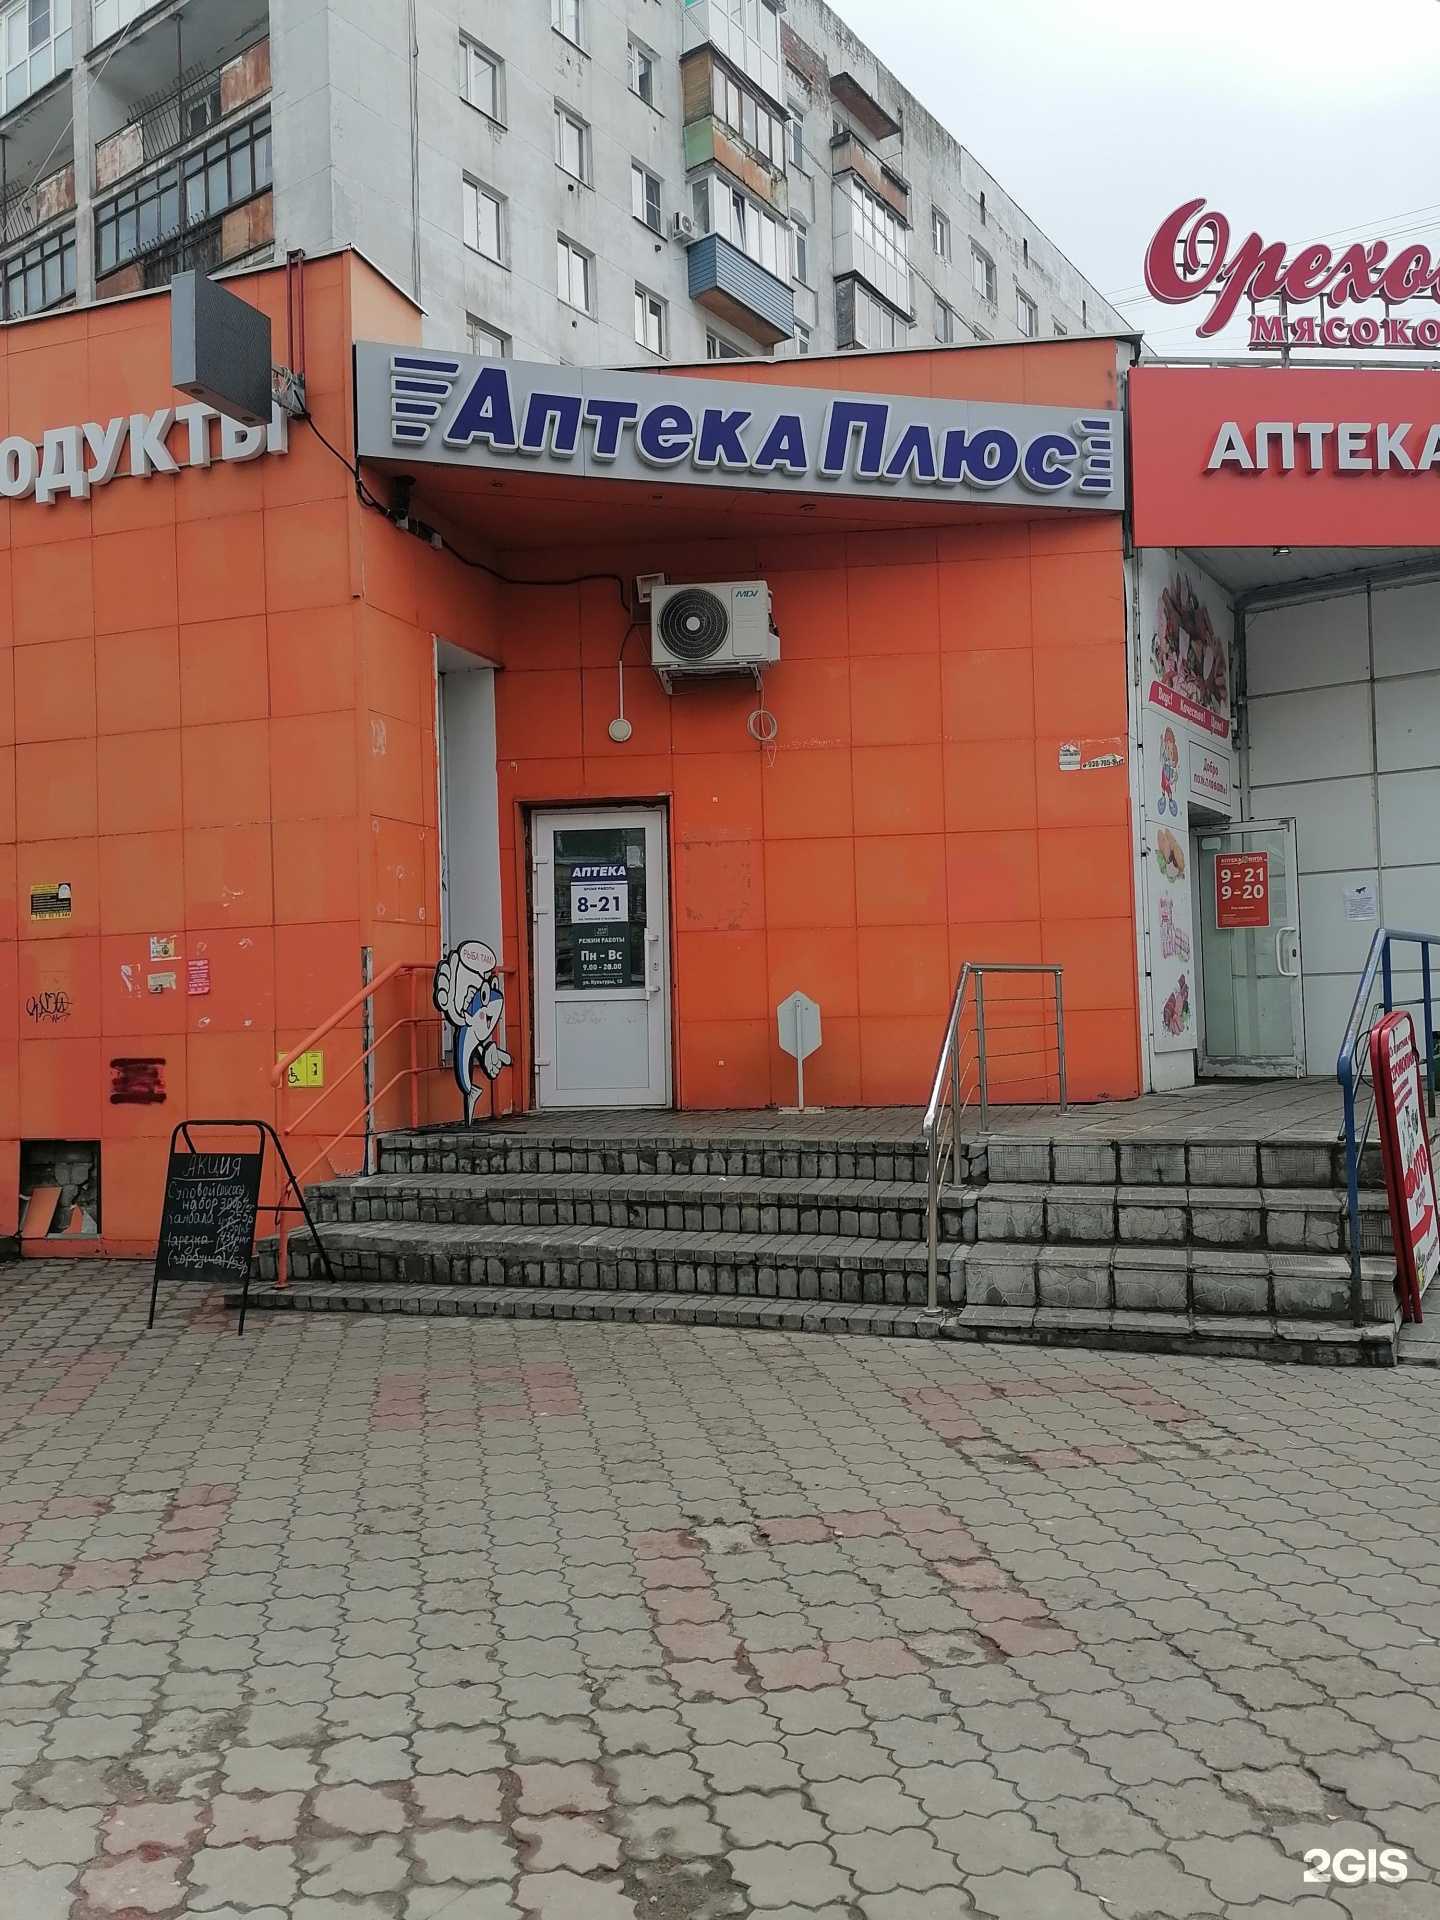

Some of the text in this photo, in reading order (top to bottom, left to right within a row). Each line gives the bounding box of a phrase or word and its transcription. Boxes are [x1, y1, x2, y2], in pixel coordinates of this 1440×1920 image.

[1145, 197, 1440, 338] Орехо
[736, 590, 759, 598] MDV
[572, 866, 627, 877] АПТЕКА
[577, 896, 620, 912] 8-21
[581, 951, 597, 961] Пн
[608, 950, 622, 960] Вс
